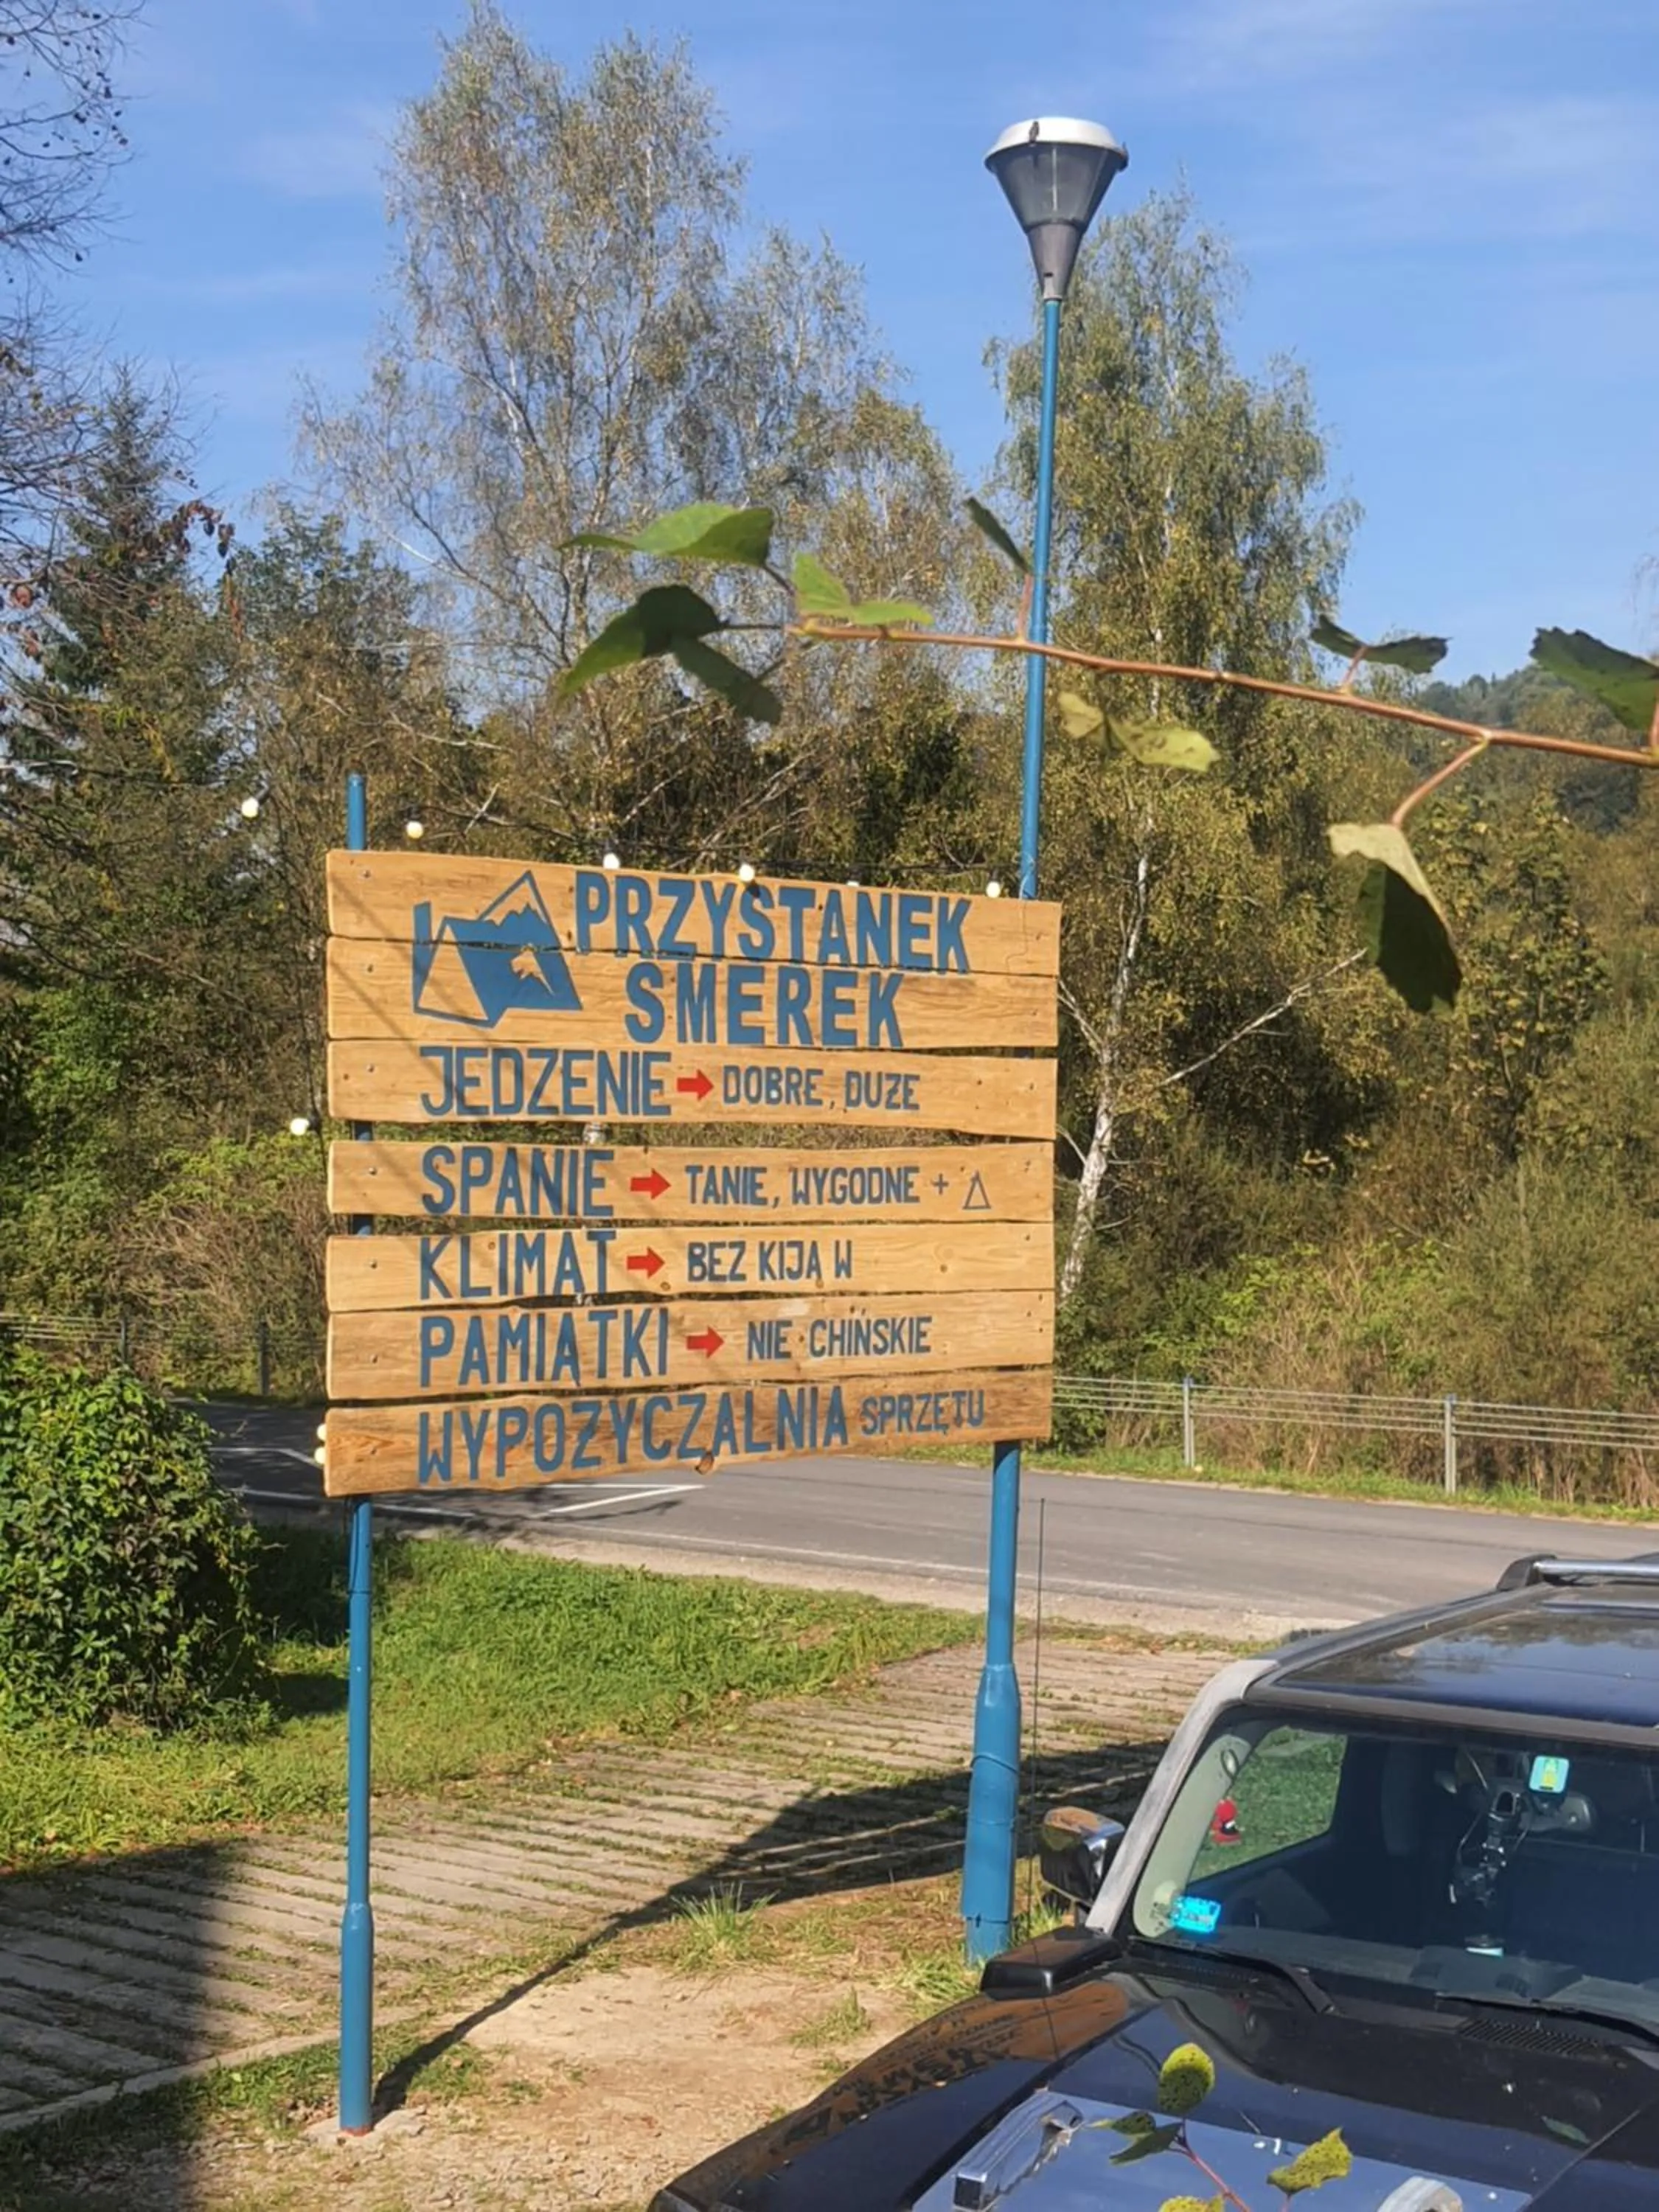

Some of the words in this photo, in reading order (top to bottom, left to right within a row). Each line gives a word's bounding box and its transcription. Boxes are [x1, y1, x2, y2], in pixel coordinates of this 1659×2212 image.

[575, 870, 972, 974] PRZYSTANEK
[625, 961, 903, 1048] SMEREK
[420, 1046, 672, 1116] JEDZENIE
[421, 1145, 614, 1217] SPANIE
[685, 1165, 780, 1208] TANIE,
[791, 1166, 920, 1205] WYGODNE
[420, 1231, 616, 1300] KLIMAT
[687, 1241, 747, 1282] BEZ
[835, 1239, 853, 1279] W
[747, 1319, 793, 1361] NIE
